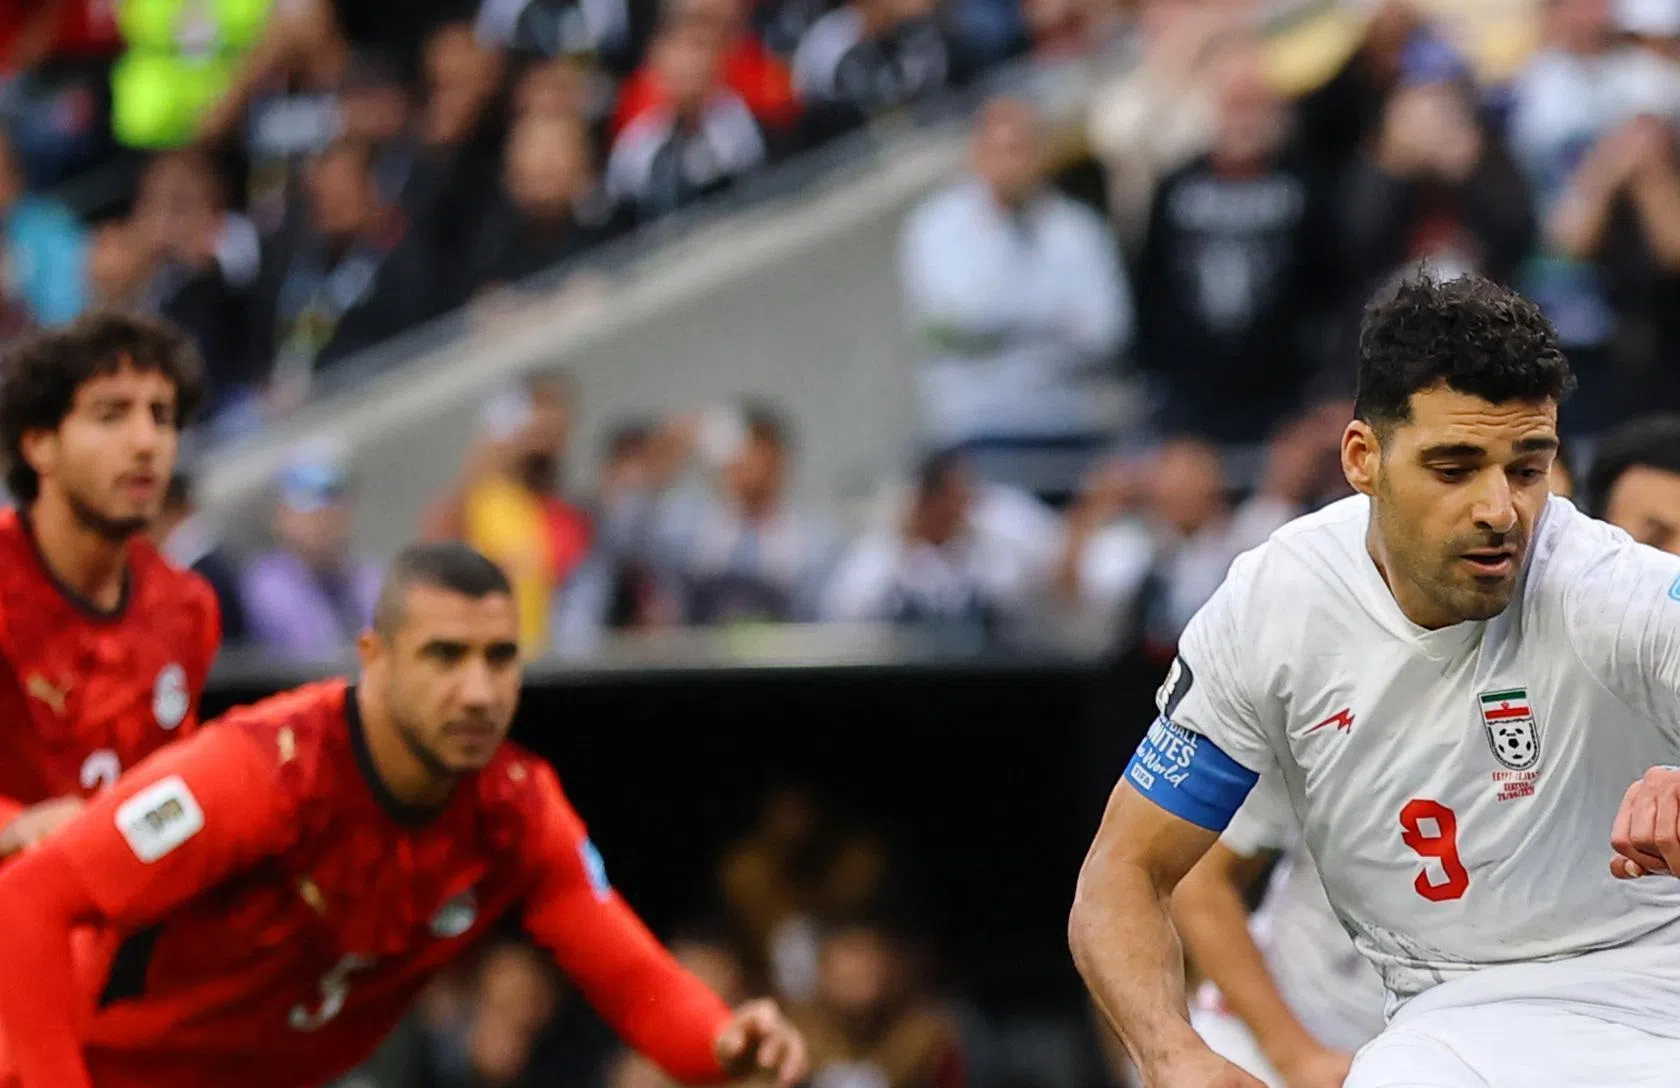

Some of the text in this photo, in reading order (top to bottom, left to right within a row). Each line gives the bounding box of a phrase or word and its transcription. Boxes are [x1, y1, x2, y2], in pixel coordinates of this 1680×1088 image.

[1131, 764, 1153, 788] FIFA
[1142, 747, 1190, 788] World
[1399, 799, 1470, 902] 9
